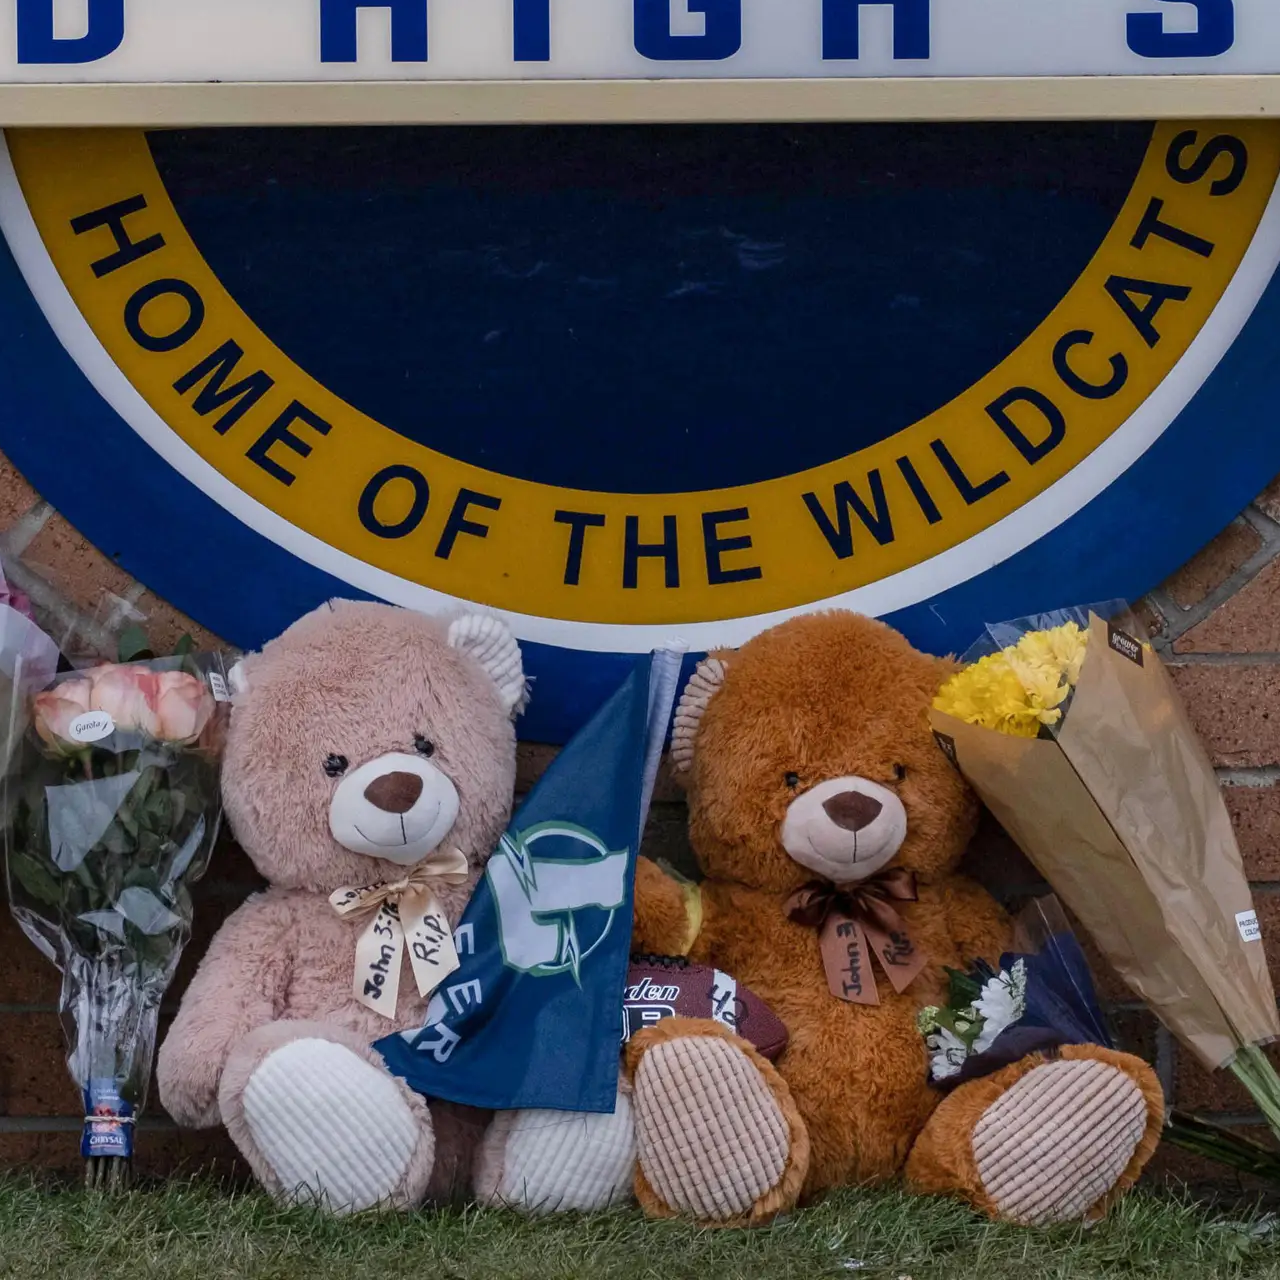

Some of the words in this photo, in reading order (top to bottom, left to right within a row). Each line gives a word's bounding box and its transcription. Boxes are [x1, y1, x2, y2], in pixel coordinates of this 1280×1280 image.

[70, 194, 332, 486] HOME
[358, 464, 502, 559] OF
[554, 507, 762, 589] THE
[802, 129, 1248, 559] WILDCATS
[363, 945, 396, 1001] John
[89, 1135, 124, 1145] CHRYSAL
